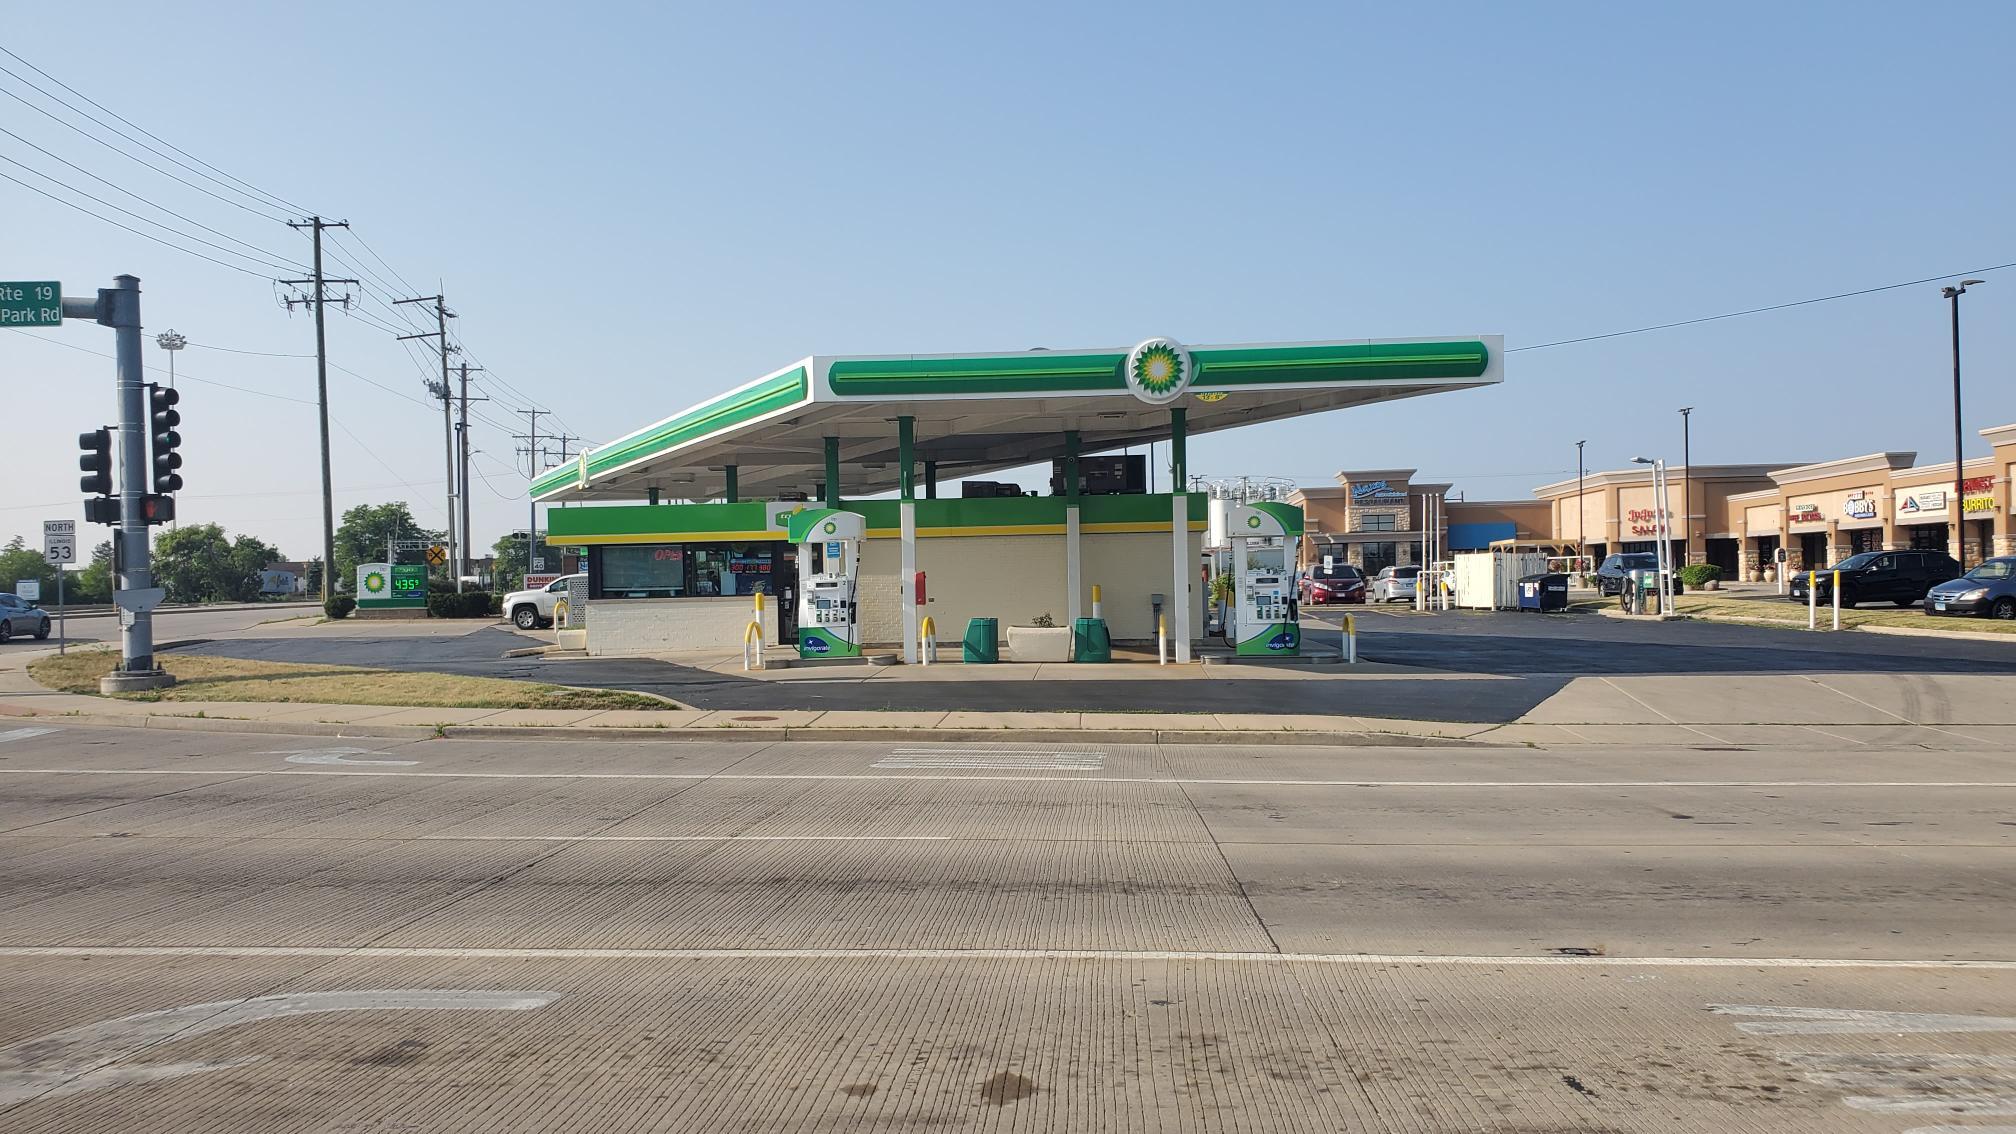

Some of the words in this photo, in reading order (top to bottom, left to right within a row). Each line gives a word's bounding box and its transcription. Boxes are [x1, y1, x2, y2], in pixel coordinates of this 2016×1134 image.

[35, 286, 52, 300] 19
[1, 307, 36, 322] Park
[41, 306, 60, 322] Rd
[45, 523, 74, 532] NORTH
[50, 545, 72, 560] 53
